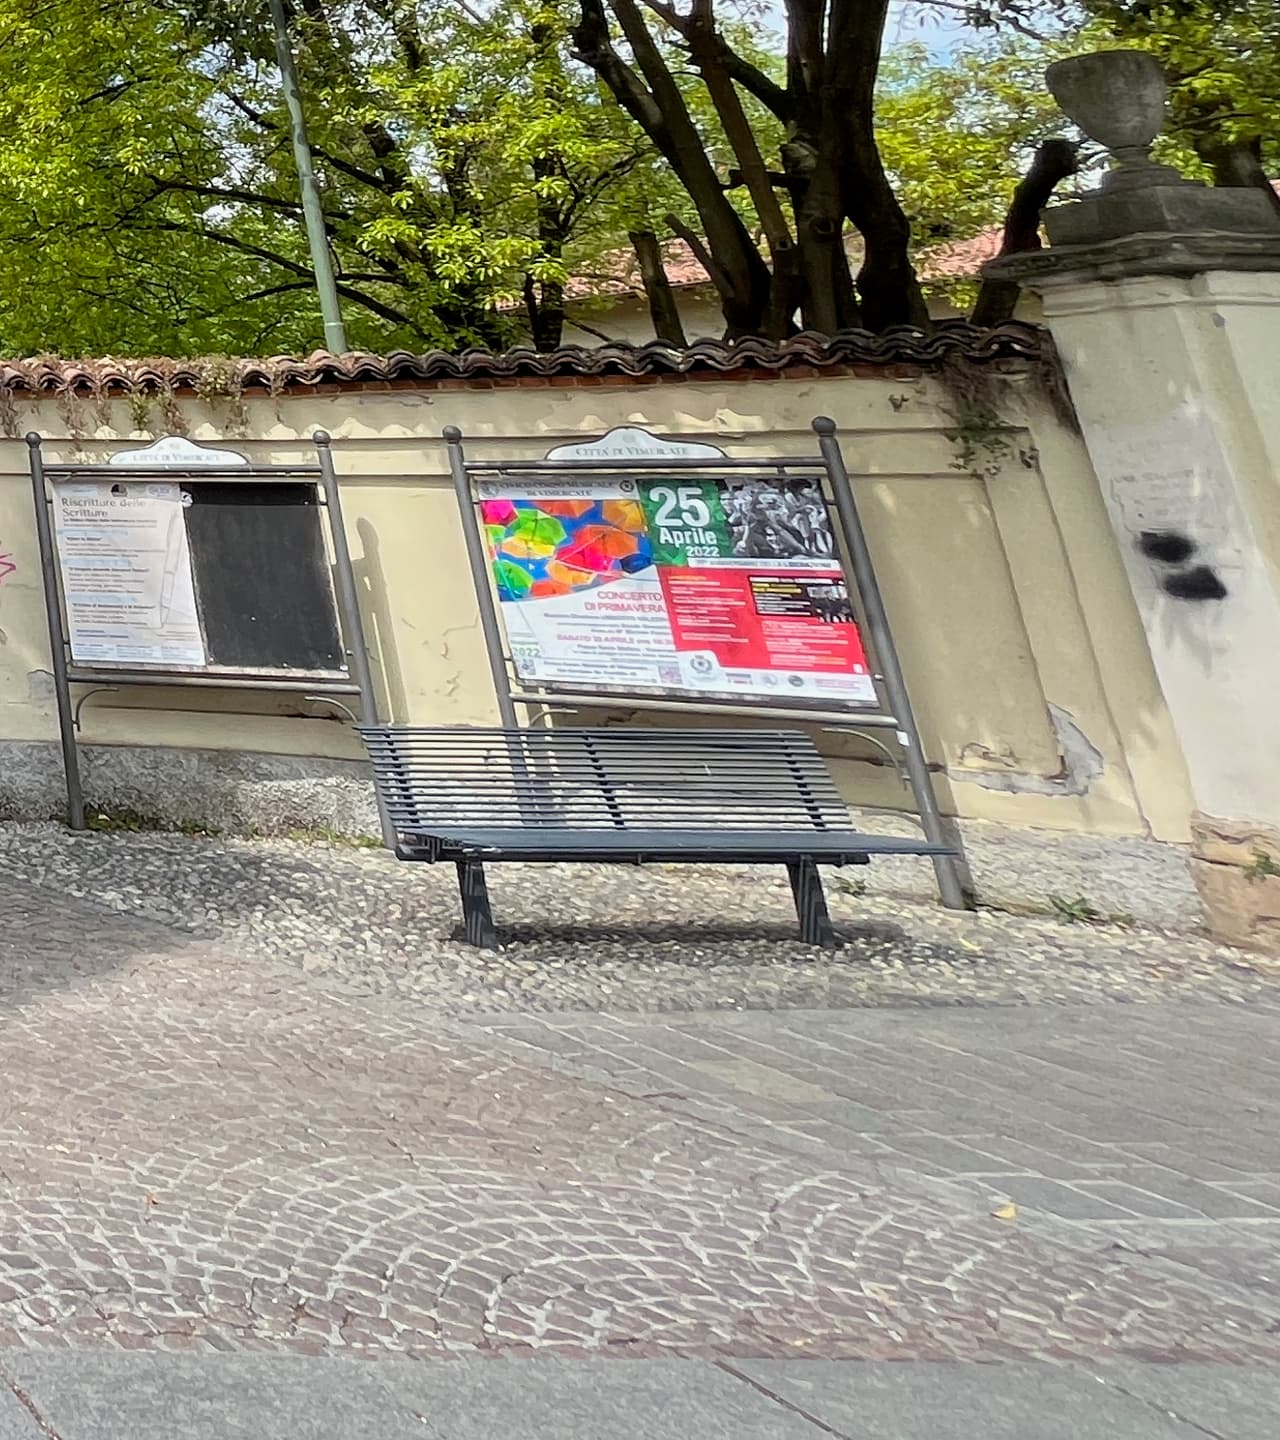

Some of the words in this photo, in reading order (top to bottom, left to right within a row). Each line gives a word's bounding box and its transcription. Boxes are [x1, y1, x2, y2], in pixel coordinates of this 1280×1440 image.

[61, 497, 117, 507] Riscritture
[649, 486, 710, 528] 25
[62, 507, 108, 518] Scritture
[659, 527, 718, 548] Aprile
[685, 546, 720, 557] 2022
[597, 590, 662, 601] CONCERTO
[584, 601, 596, 611] DI
[597, 602, 666, 613] PRIMAVERA
